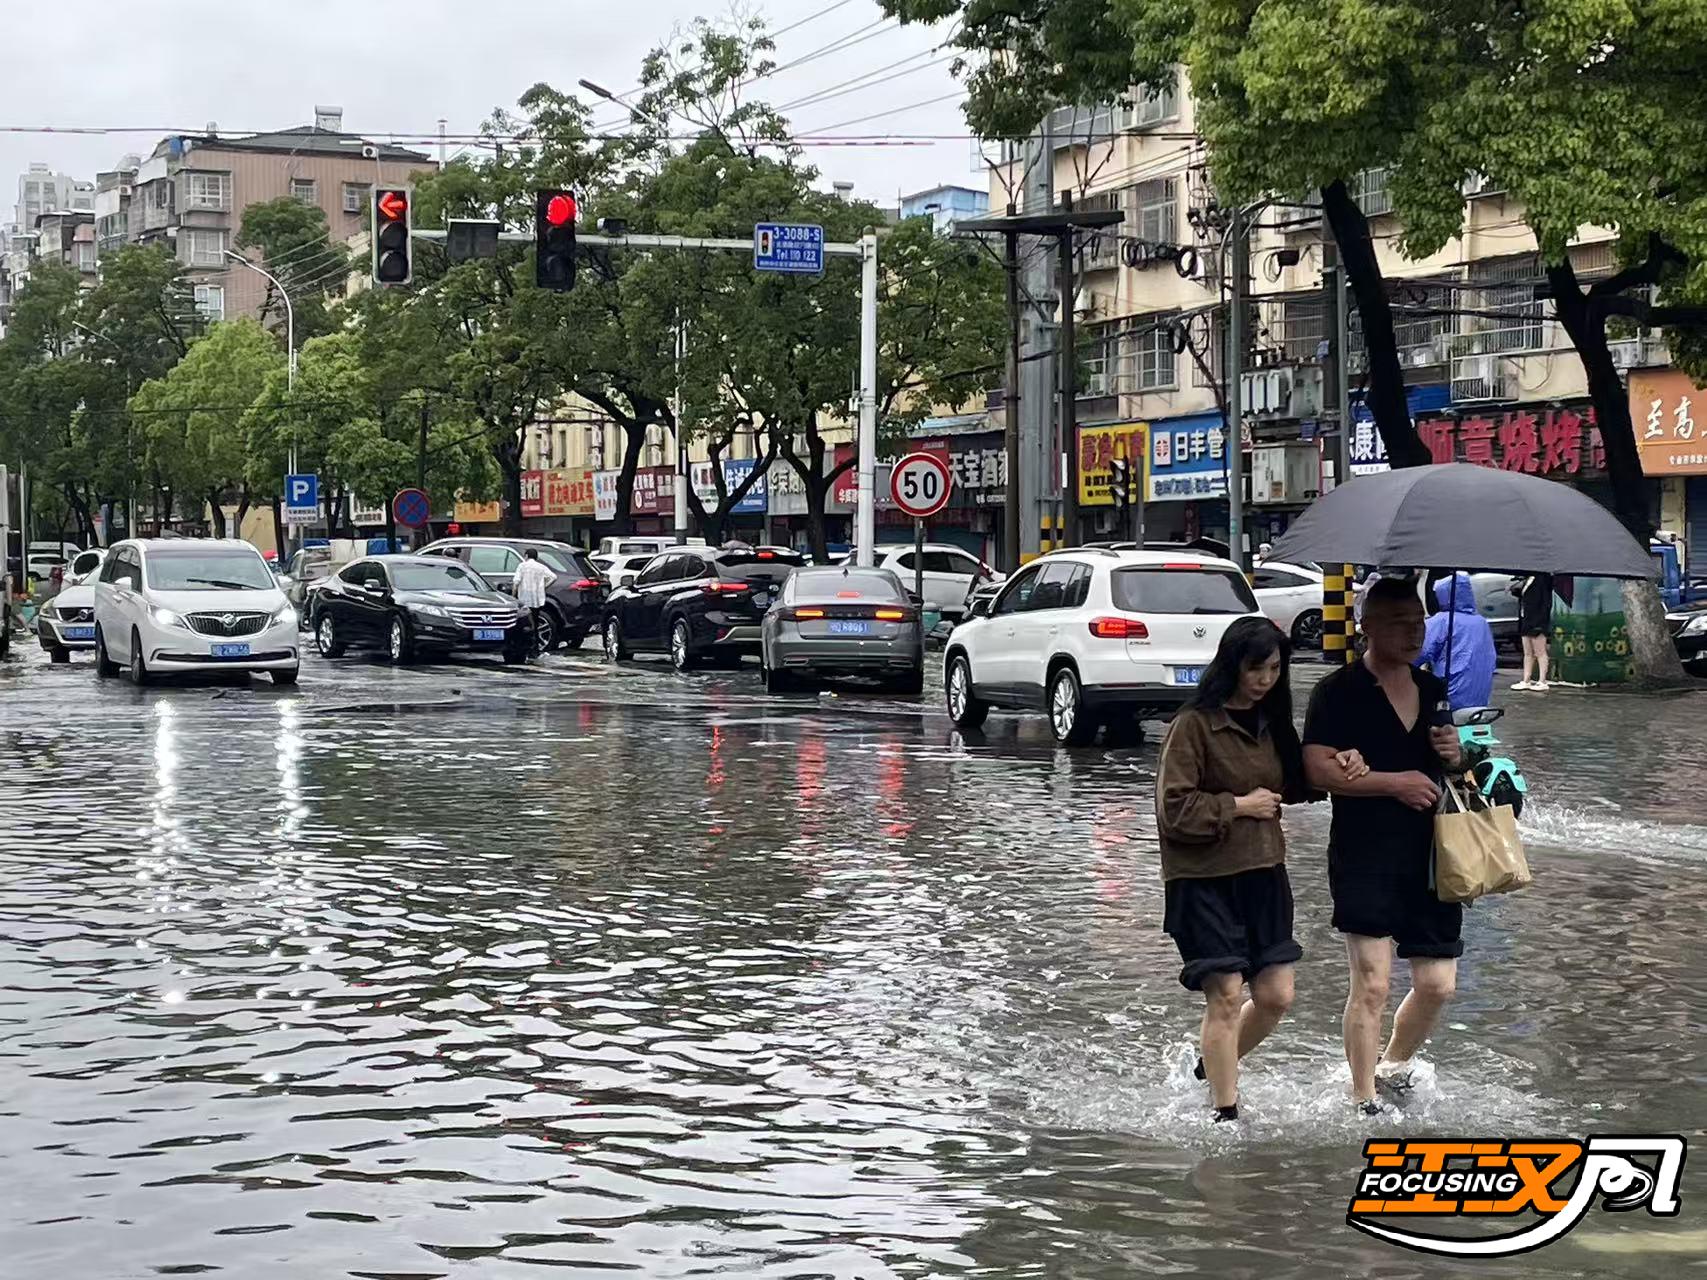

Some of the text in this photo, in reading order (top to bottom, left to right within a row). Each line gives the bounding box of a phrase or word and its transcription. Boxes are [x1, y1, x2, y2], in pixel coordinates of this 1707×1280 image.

[773, 227, 820, 241] 3-3088-S
[1644, 395, 1707, 439] 至高
[1175, 427, 1224, 461] 日丰管
[293, 481, 310, 501] P
[904, 471, 938, 499] 50
